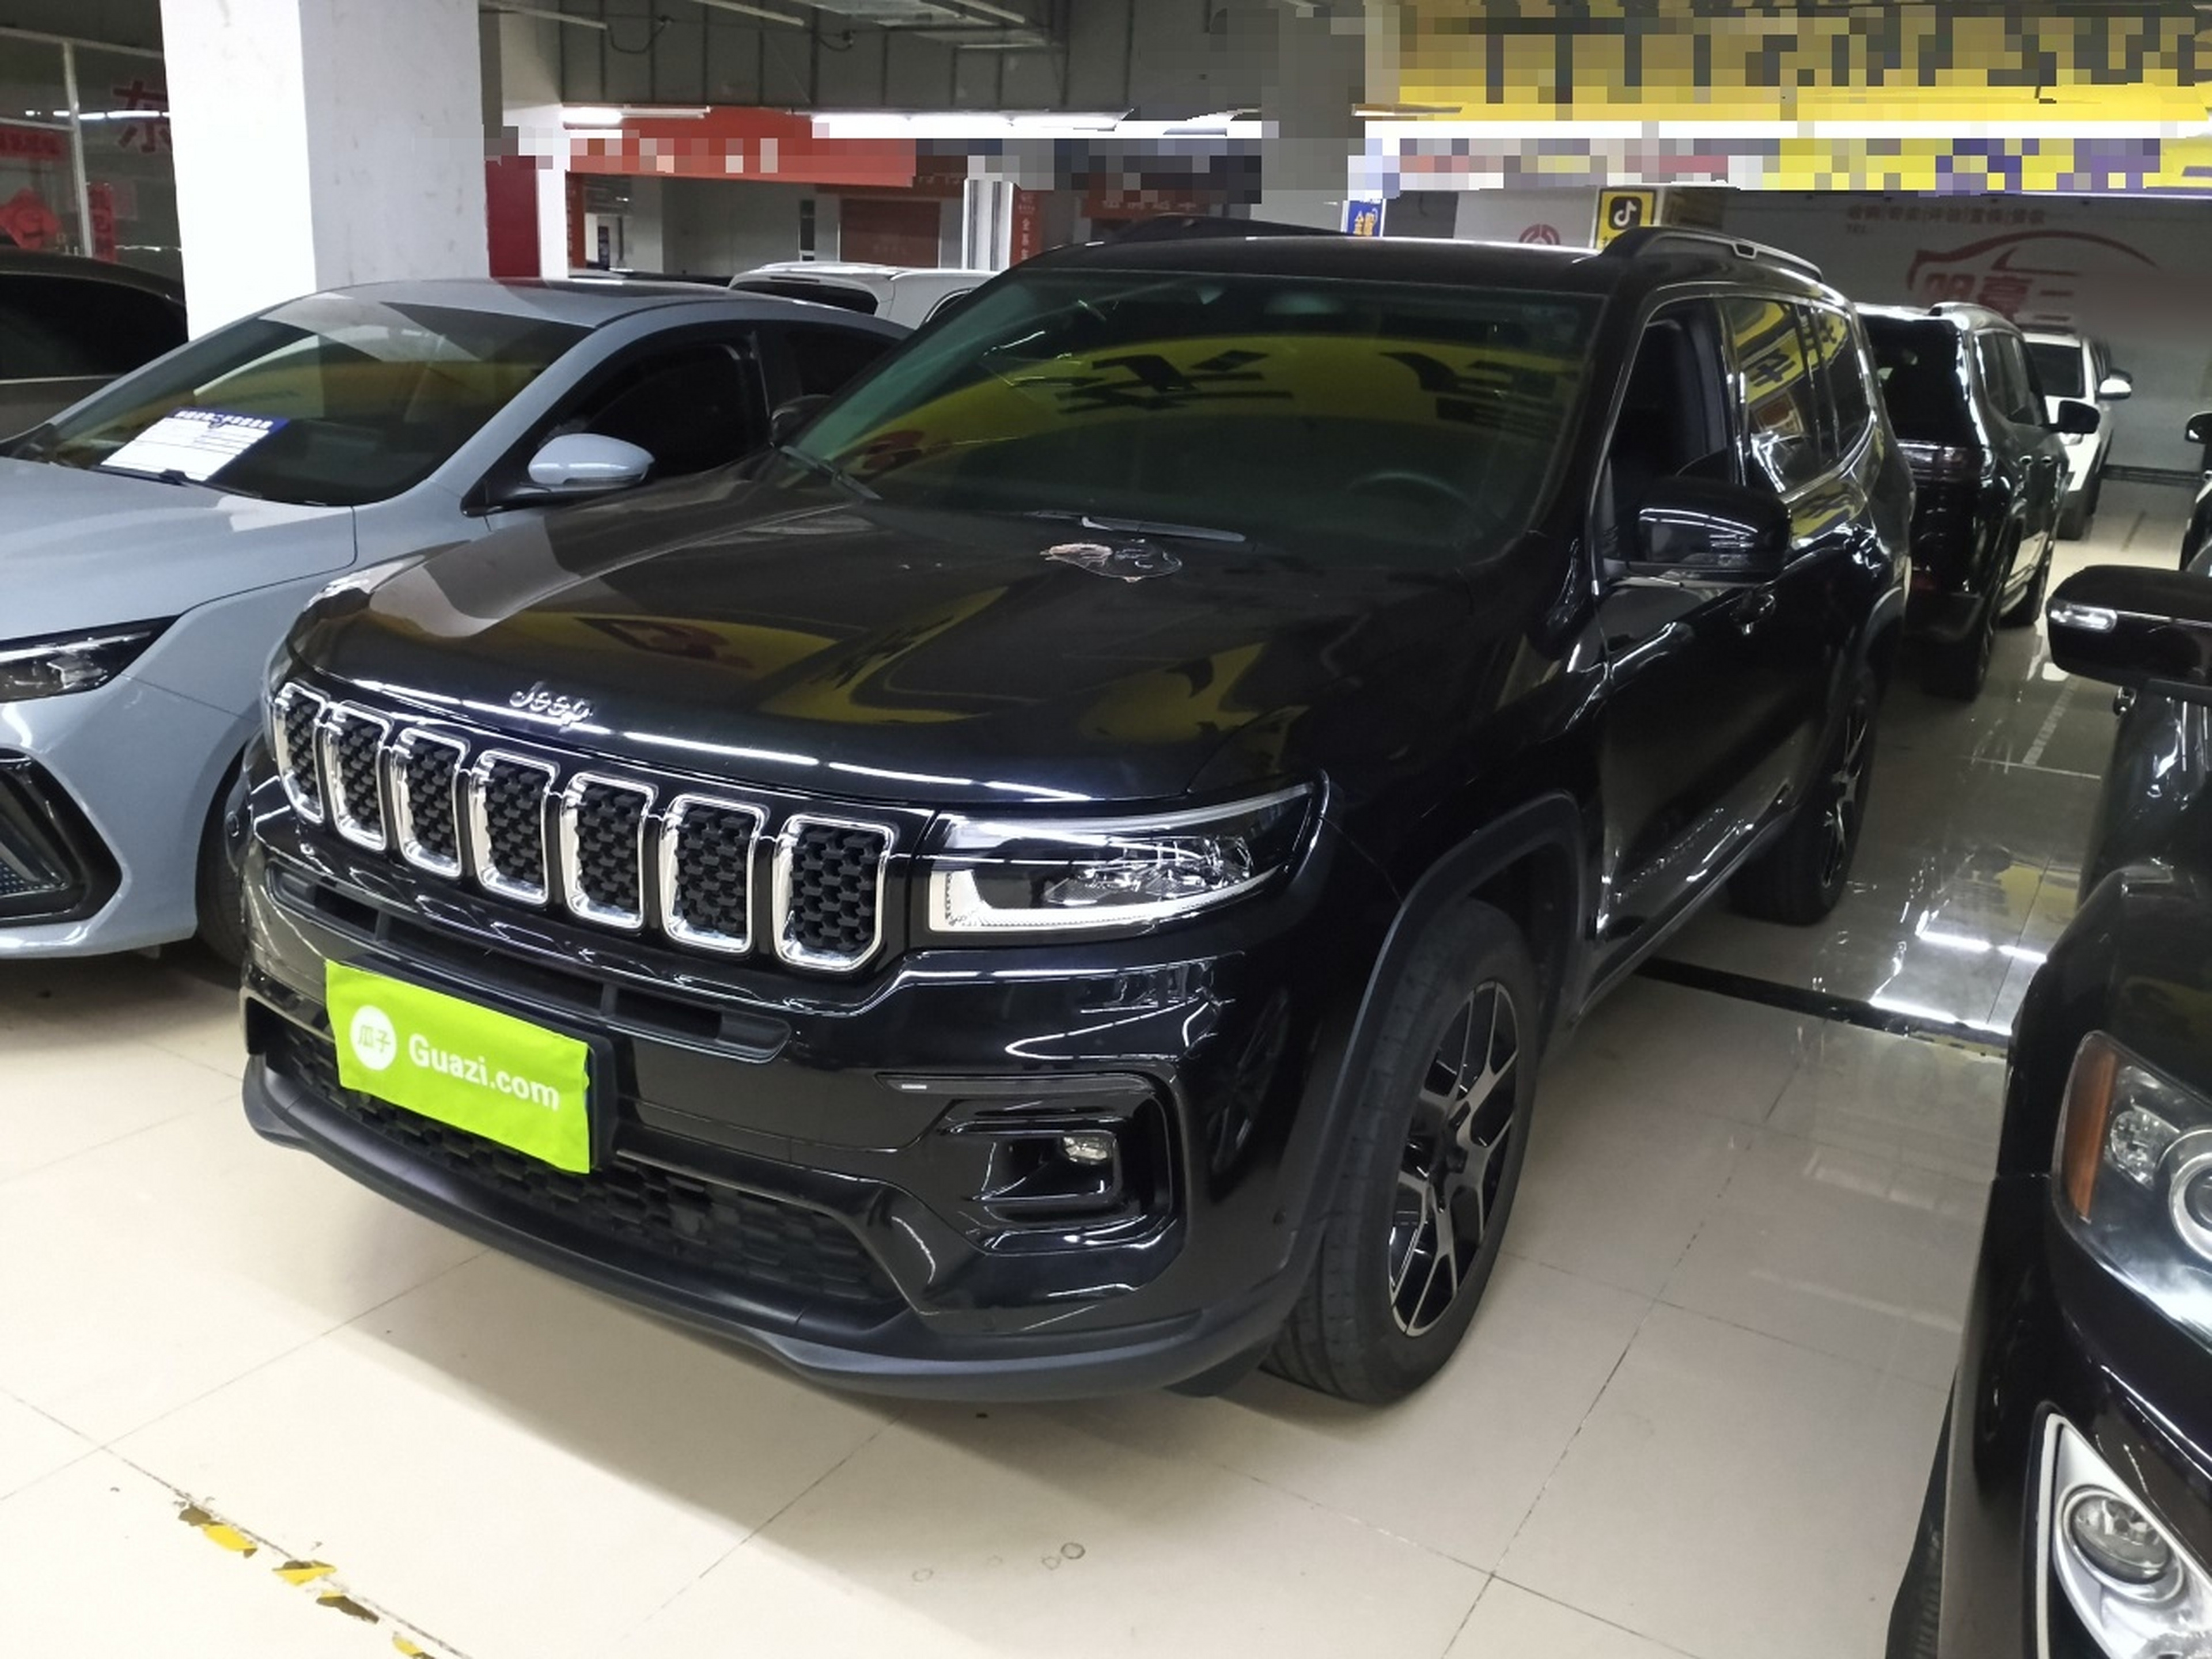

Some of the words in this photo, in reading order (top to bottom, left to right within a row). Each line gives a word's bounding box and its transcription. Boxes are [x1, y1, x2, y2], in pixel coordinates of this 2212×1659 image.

[510, 681, 593, 733] Jeep
[357, 1024, 391, 1054] 瓜子
[408, 1032, 559, 1111] Guazi.com
